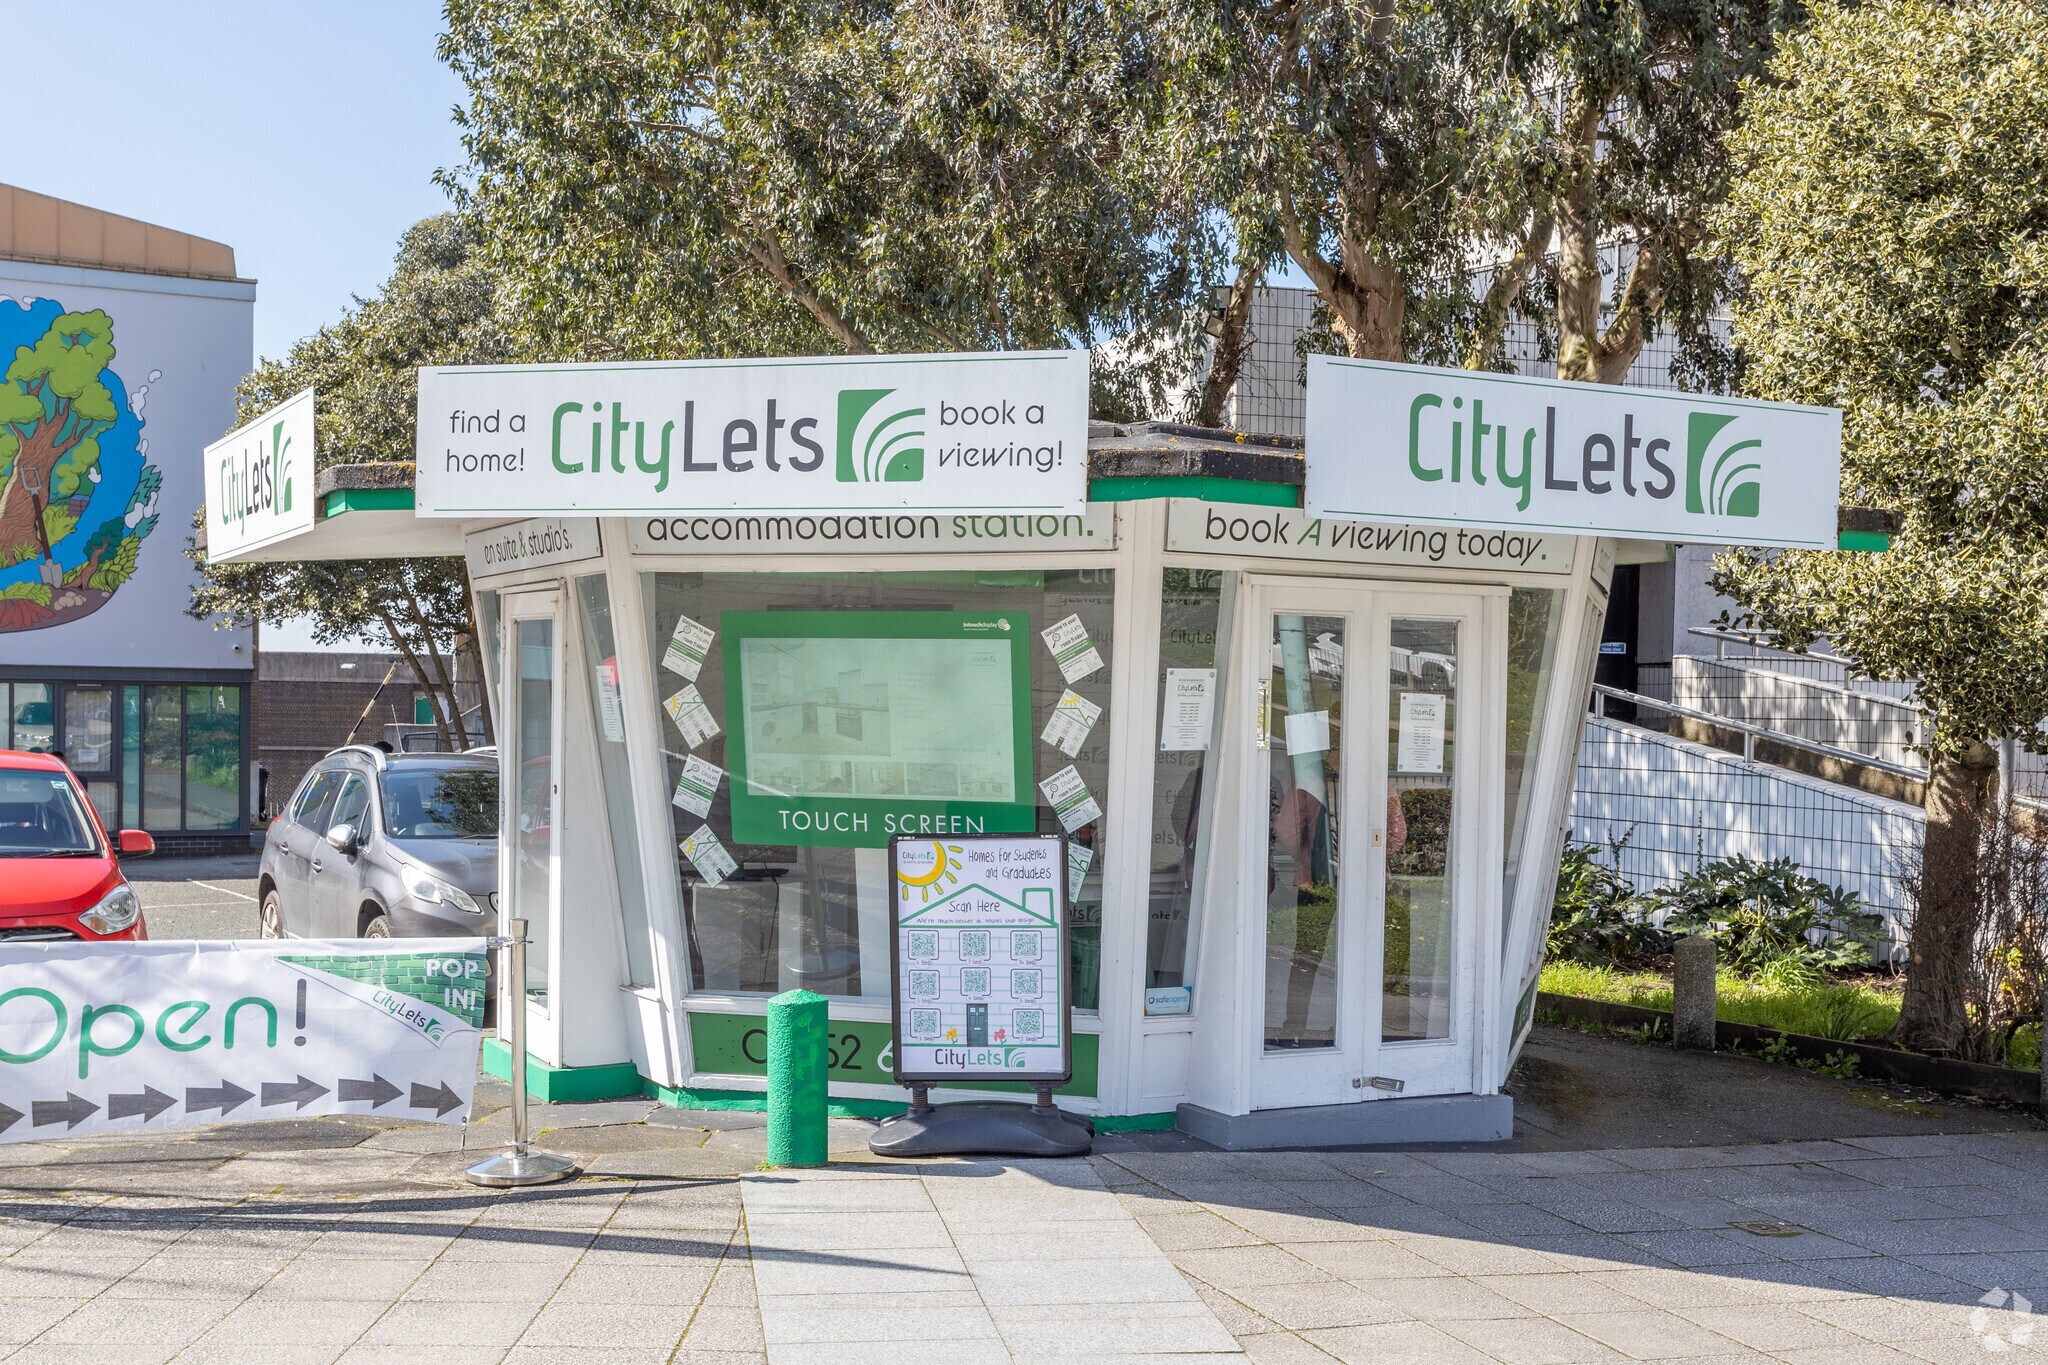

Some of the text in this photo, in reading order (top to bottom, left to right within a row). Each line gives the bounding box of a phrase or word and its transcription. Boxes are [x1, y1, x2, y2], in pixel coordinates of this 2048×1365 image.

[449, 408, 527, 435] find a
[939, 400, 1044, 426] book a
[550, 398, 825, 494] CityLets
[938, 439, 1064, 473] viewing!
[1408, 392, 1676, 512] CityLets
[445, 447, 526, 473] home!
[220, 440, 273, 537] CityLets
[646, 514, 1094, 542] accommodation station.
[1205, 508, 1547, 567] book A viewing today.
[484, 519, 573, 565] en suite & studio's.
[778, 810, 985, 834] TOUCH SCREEN
[968, 849, 995, 863] Homes
[1013, 847, 1047, 862] Students
[985, 865, 1052, 880] and Graduates
[948, 900, 1000, 913] Scan Here
[426, 958, 479, 979] POP
[372, 989, 428, 1028] CityLets
[444, 987, 476, 1012] IN!
[0, 978, 307, 1080] Open!
[934, 1048, 1003, 1069] CityLets
